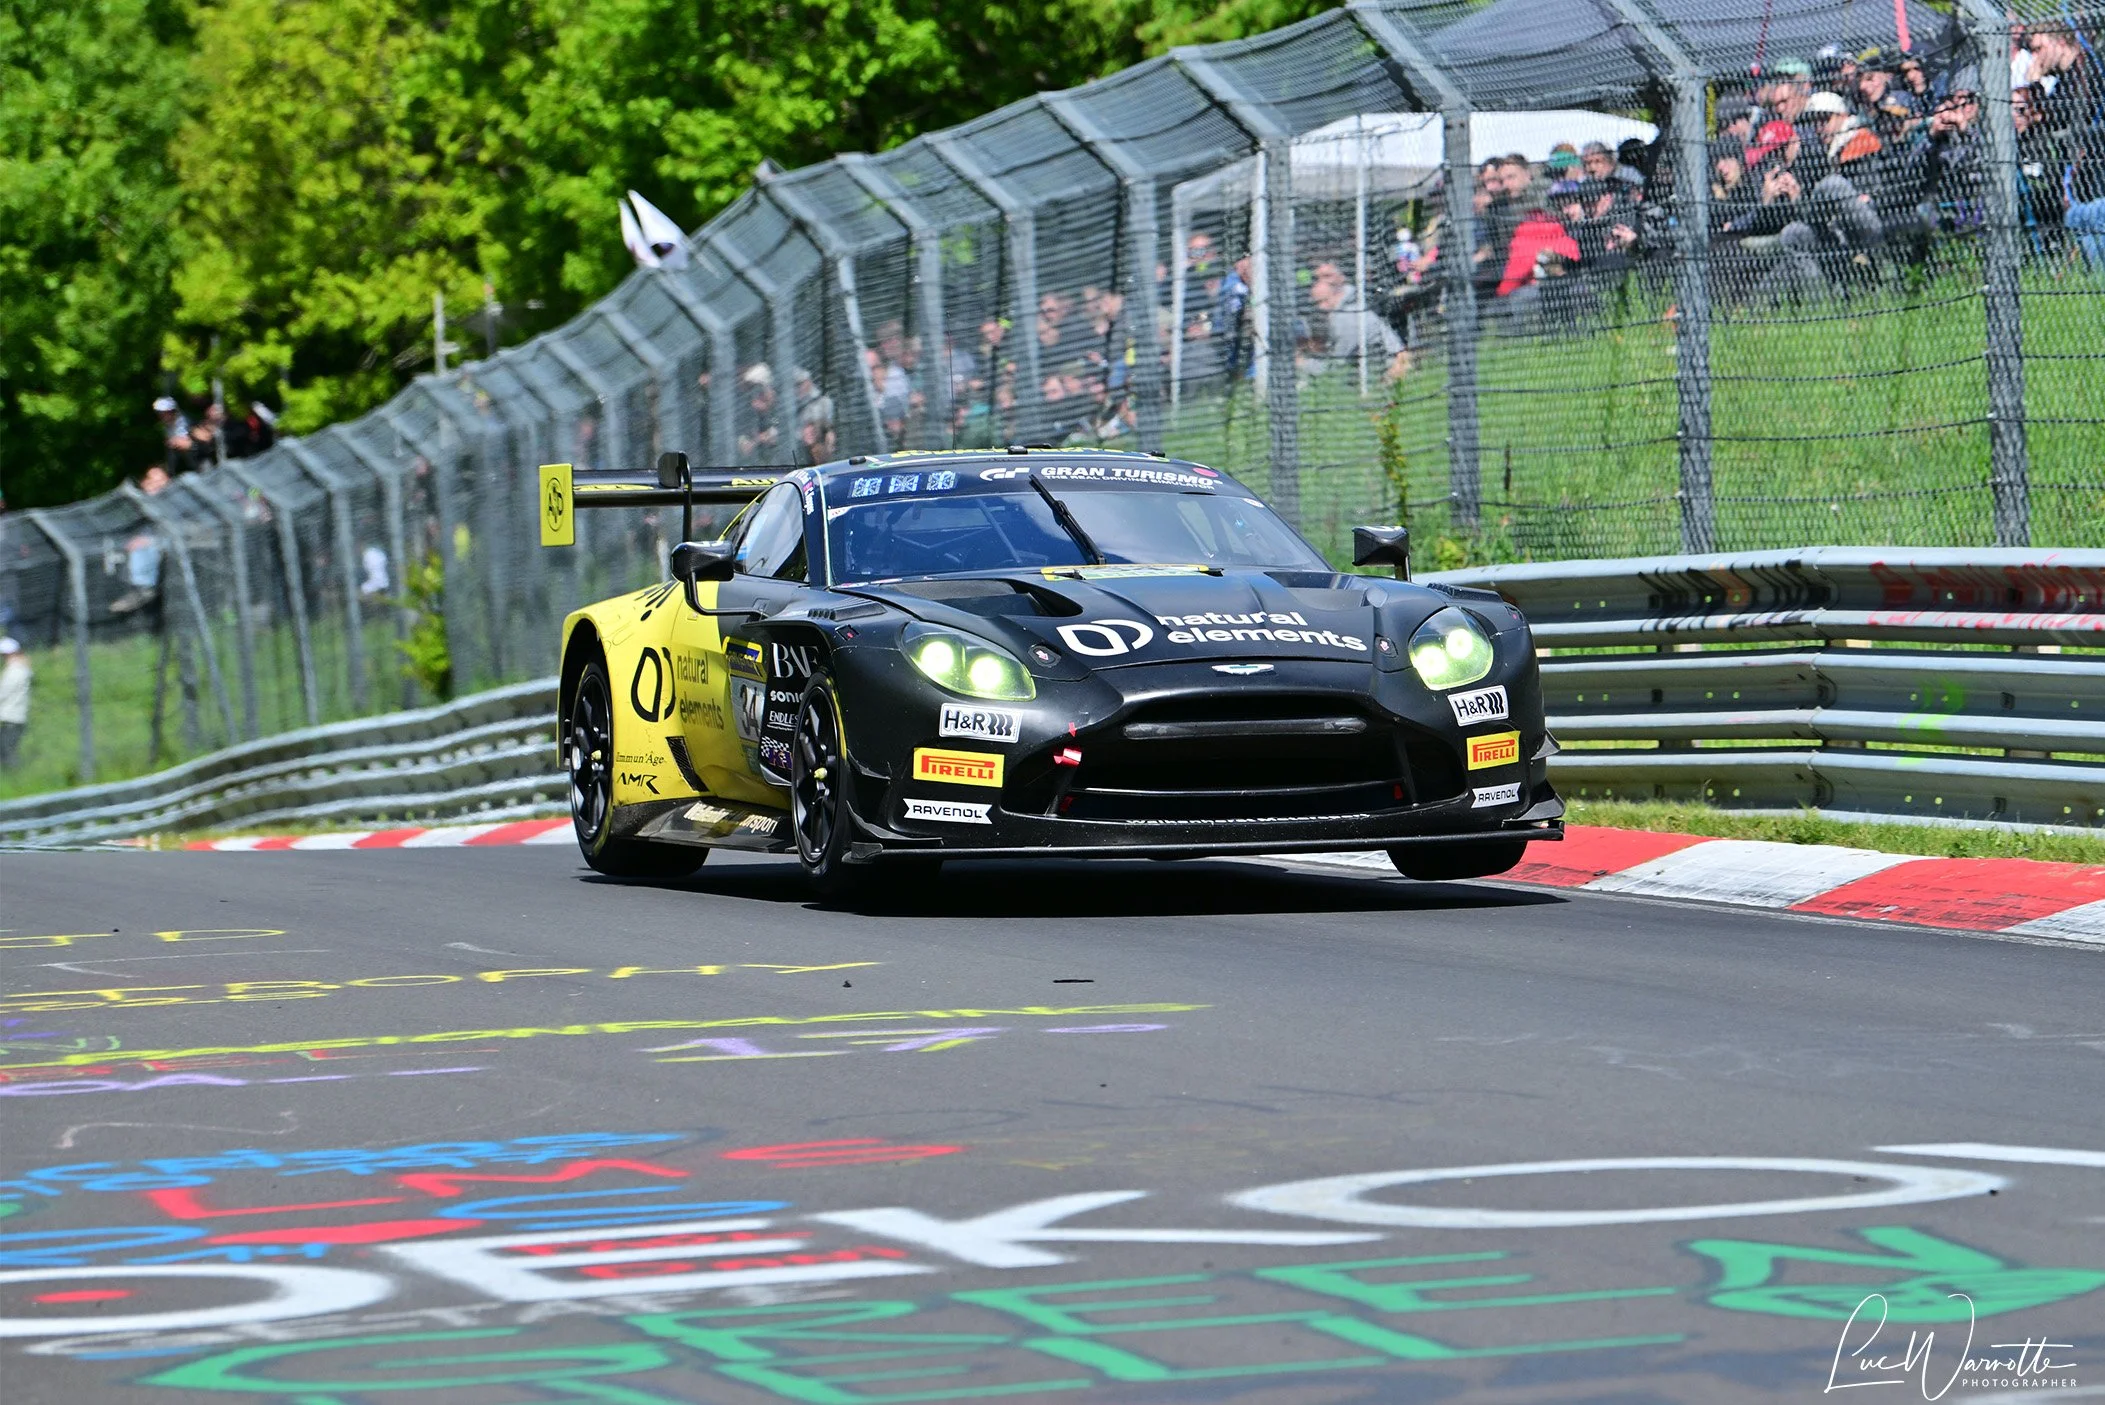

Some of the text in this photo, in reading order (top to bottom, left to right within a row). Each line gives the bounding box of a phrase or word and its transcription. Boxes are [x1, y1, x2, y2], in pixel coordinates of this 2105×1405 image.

[1041, 466, 1105, 477] GRAN
[1150, 479, 1216, 490] SIMULATOR
[1154, 611, 1309, 626] natural
[1167, 627, 1369, 651] elements
[677, 650, 709, 685] natural
[680, 691, 724, 730] elements
[1454, 696, 1488, 717] H&R
[944, 710, 986, 732] H&R
[1472, 739, 1515, 763] PIRELLI
[921, 754, 996, 780] PIRELLI
[617, 771, 661, 795] AMR
[1478, 789, 1517, 803] RAVENOL
[912, 804, 983, 819] RAVENOL
